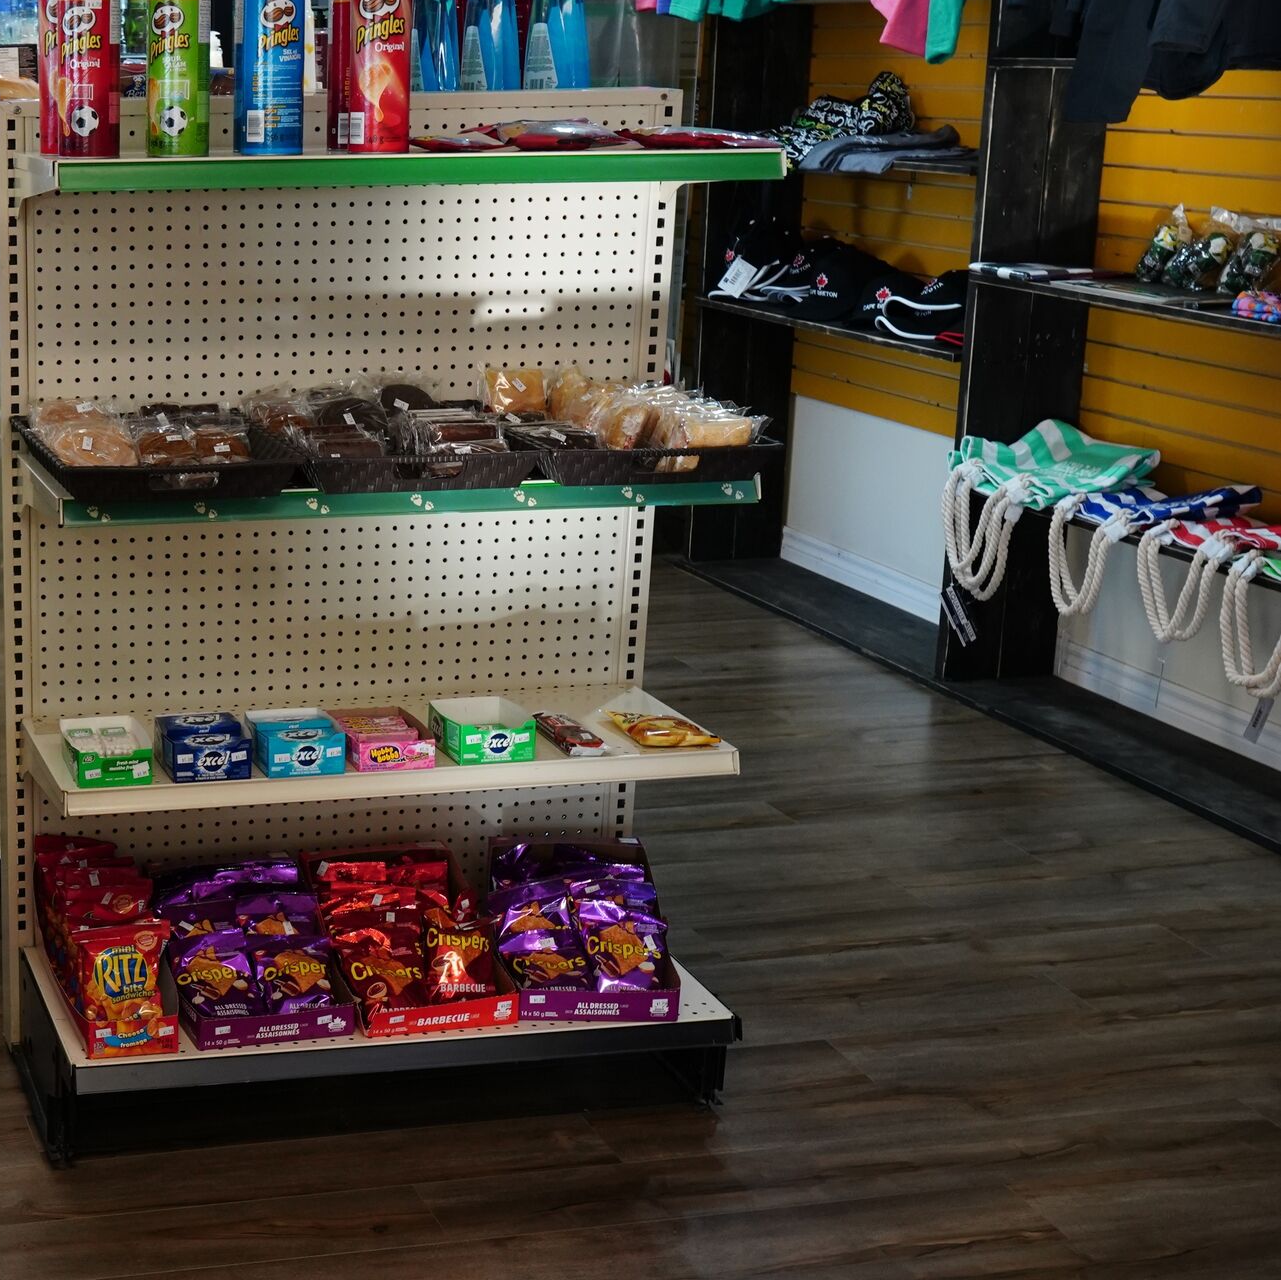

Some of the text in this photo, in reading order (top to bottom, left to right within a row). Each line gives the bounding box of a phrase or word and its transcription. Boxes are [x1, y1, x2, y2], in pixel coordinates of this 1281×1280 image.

[258, 26, 300, 58] Pringles
[356, 17, 405, 54] Pringles
[61, 32, 101, 64] Pringles
[150, 32, 189, 65] Pringles
[374, 41, 405, 53] Original
[70, 58, 101, 69] Original
[482, 735, 516, 750] excel
[197, 750, 231, 767] excel
[291, 744, 325, 763] excel
[370, 746, 392, 757] Hubba
[377, 750, 400, 763] Bubba
[426, 927, 490, 952] Crispers
[111, 945, 135, 954] mini
[587, 936, 662, 960] Crispers
[95, 952, 146, 994] RITZ
[176, 966, 242, 986] Crisper
[263, 961, 327, 982] Crisper
[122, 983, 143, 995] bits
[439, 982, 487, 993] BARBECUE
[112, 989, 156, 1005] sandwiches
[417, 1012, 470, 1027] BARBECUE
[117, 1028, 145, 1039] Cheese
[258, 1023, 299, 1033] ALL DRESSED
[120, 1038, 148, 1049] fromage
